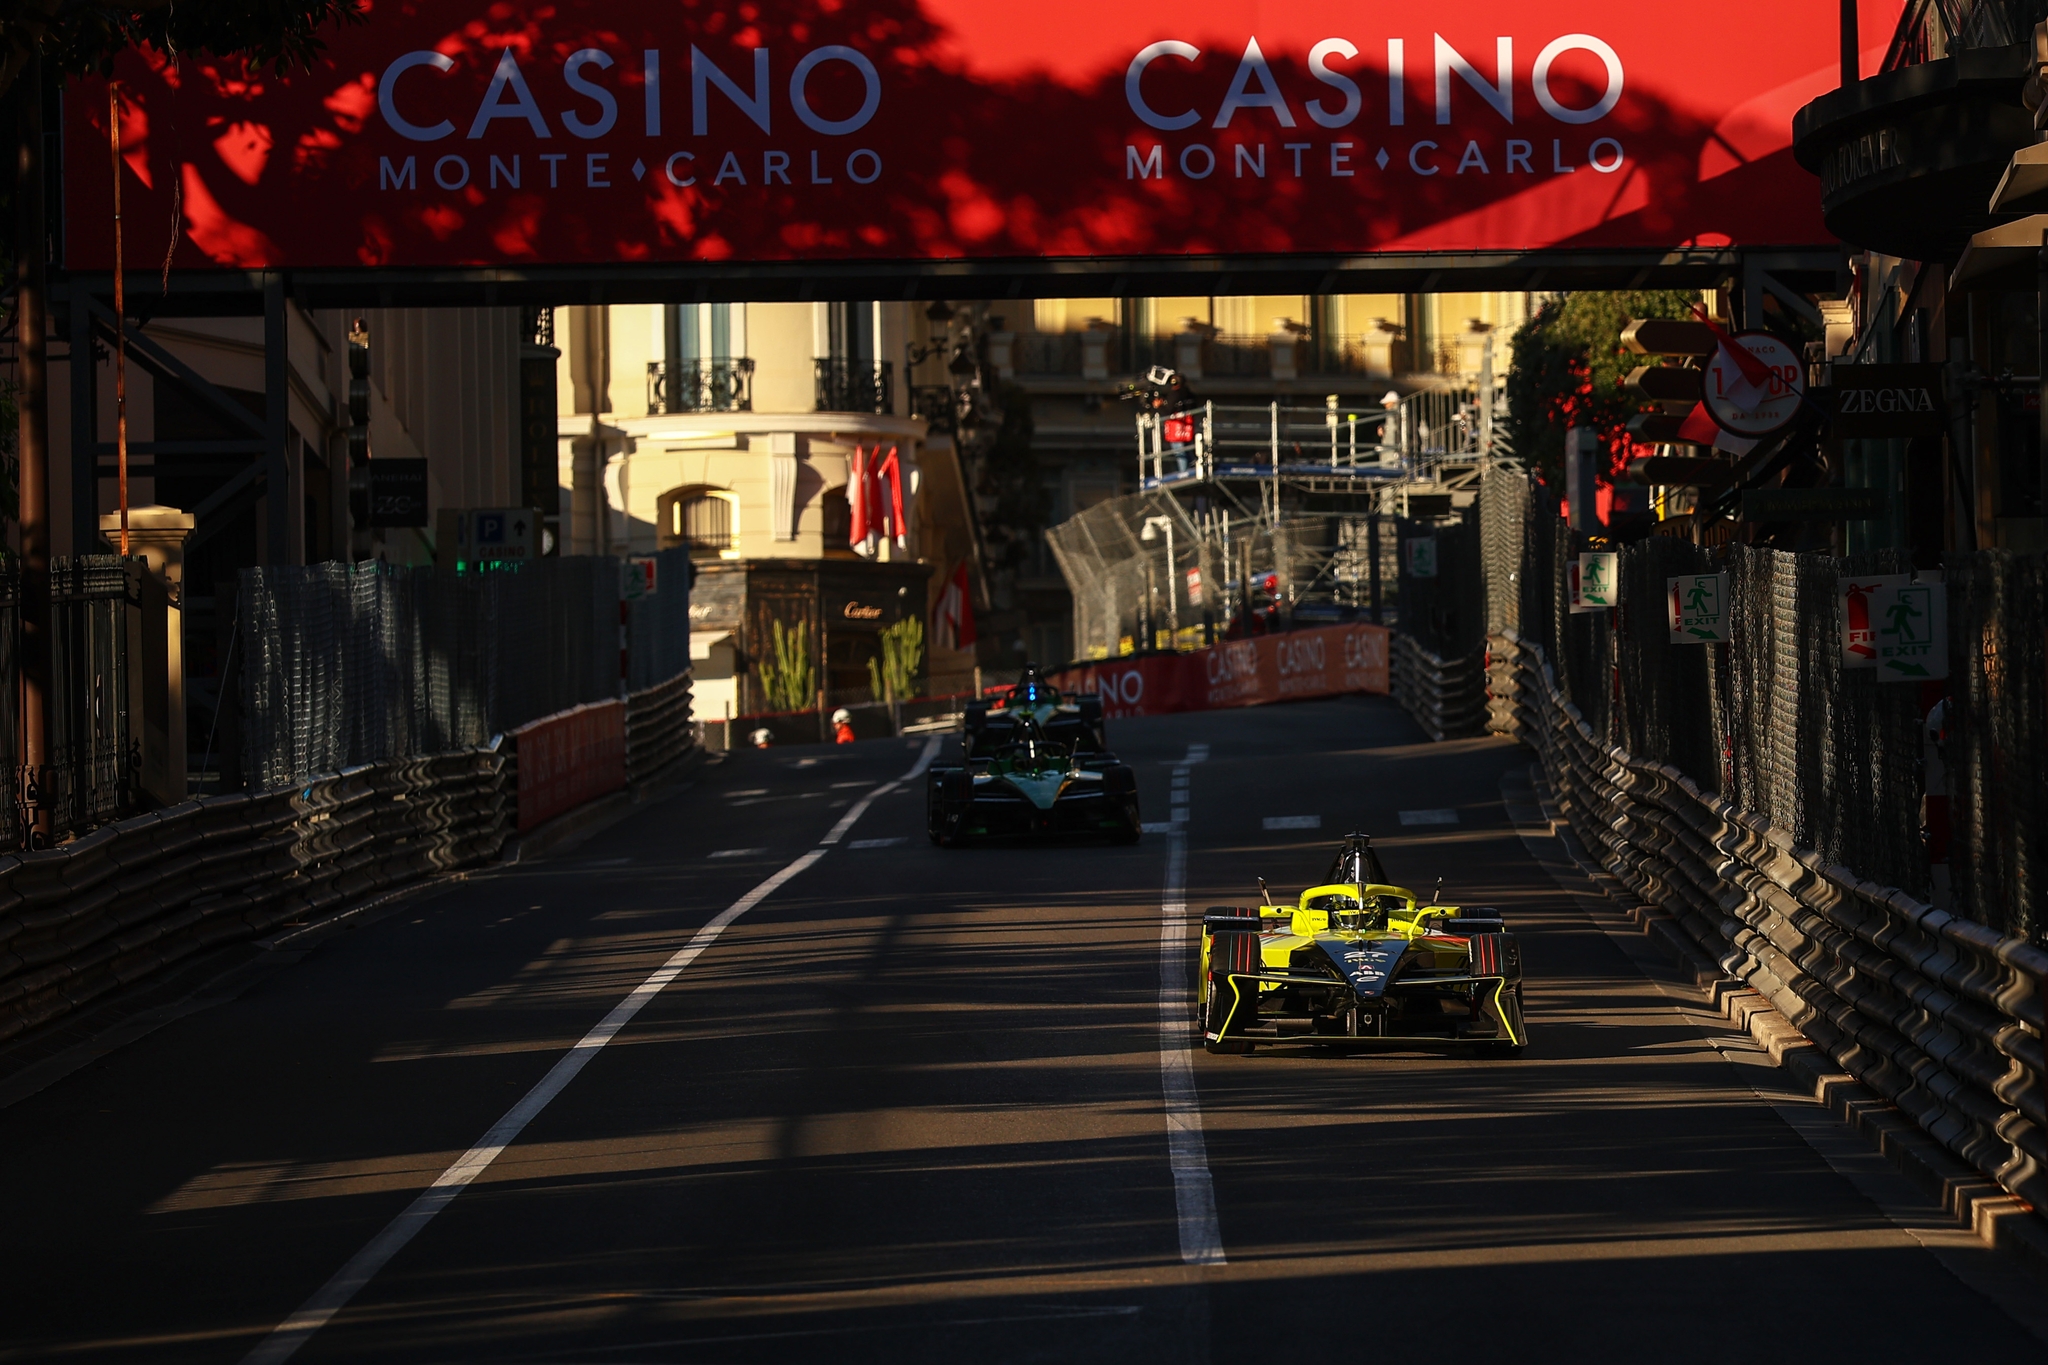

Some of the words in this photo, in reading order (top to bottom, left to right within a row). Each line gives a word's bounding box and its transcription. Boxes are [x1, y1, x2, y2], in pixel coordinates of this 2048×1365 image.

[378, 43, 881, 141] CASINO
[1125, 32, 1624, 131] CASINO
[380, 153, 611, 191] MONTE
[665, 148, 882, 187] CARLO
[1126, 142, 1355, 180] MONTE
[1408, 137, 1624, 175] CARLO
[1838, 127, 1905, 188] FOREVER
[1839, 388, 1936, 414] ZEGNA
[370, 473, 422, 483] ANERAI
[484, 519, 498, 538] P
[479, 546, 525, 558] CASINO
[843, 600, 883, 620] Cartier
[1684, 616, 1720, 626] EXIT
[1276, 635, 1325, 675] CASINO
[1882, 645, 1932, 657] EXIT
